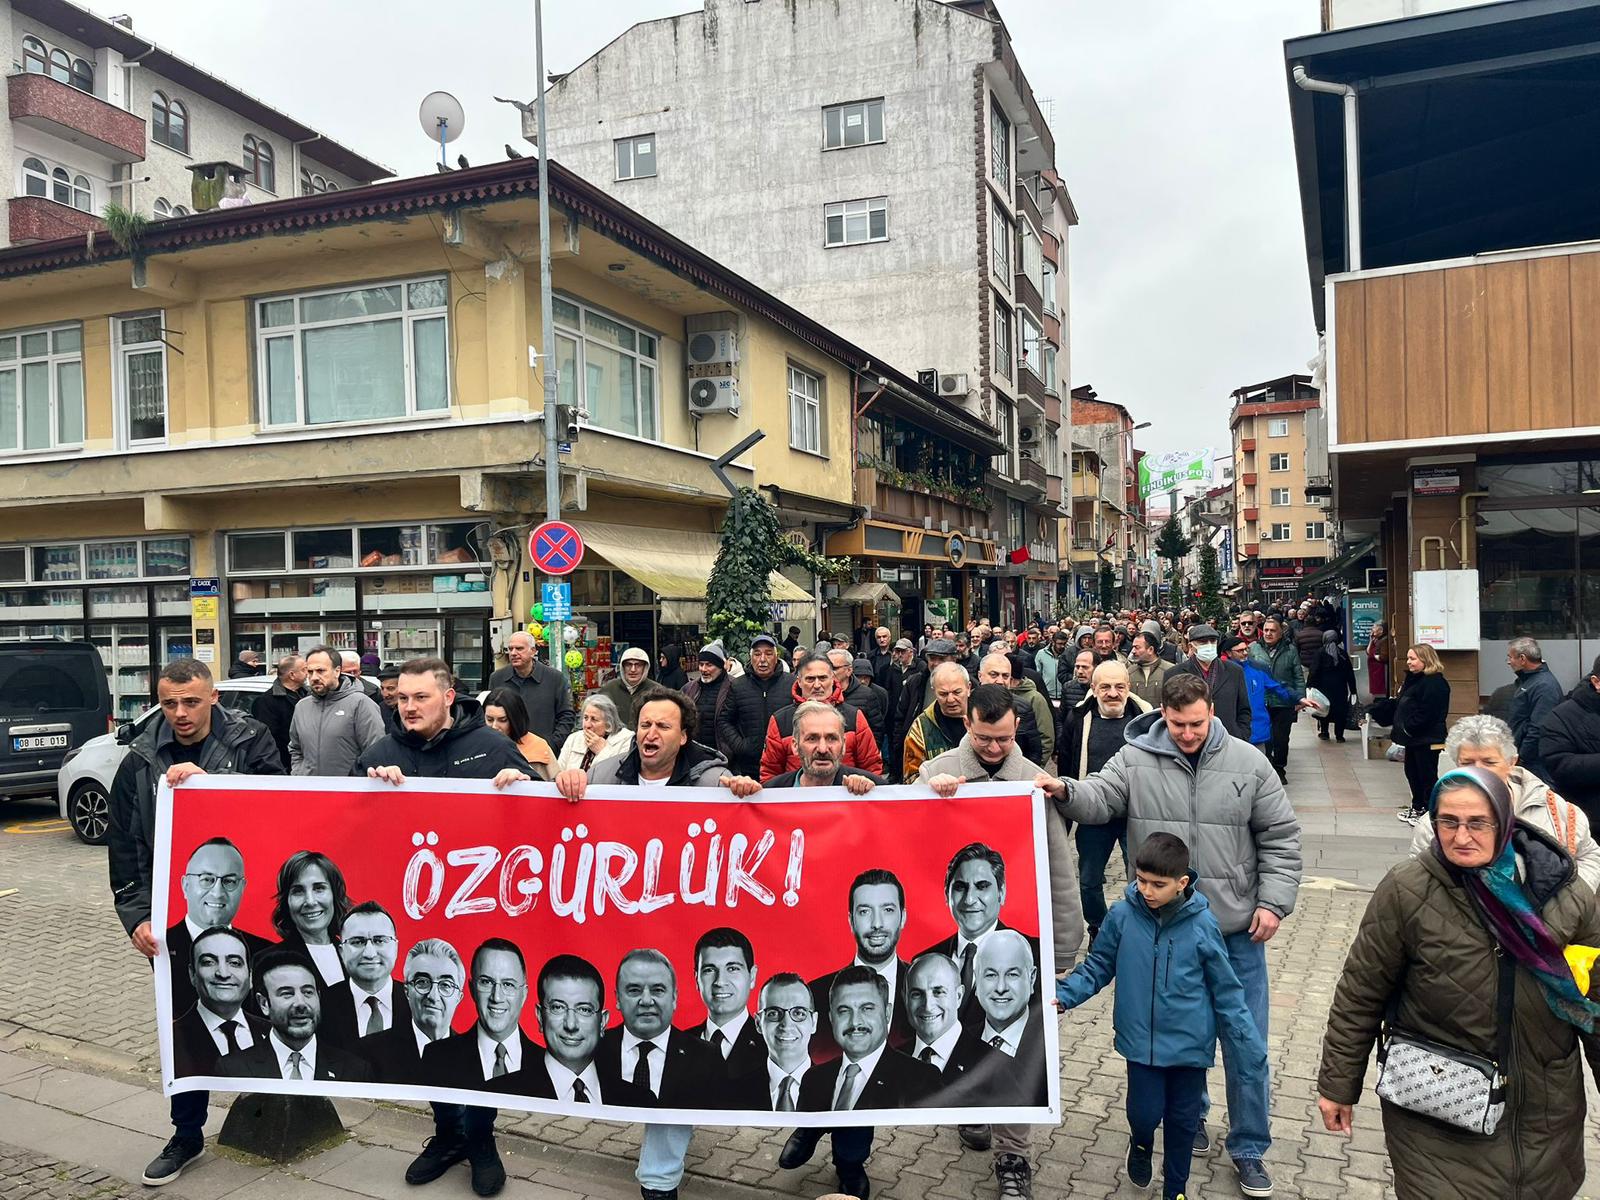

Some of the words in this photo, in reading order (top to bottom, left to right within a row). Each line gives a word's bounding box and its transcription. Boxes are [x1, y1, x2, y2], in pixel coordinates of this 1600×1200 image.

[19, 739, 30, 748] 08
[34, 738, 45, 747] DE
[50, 736, 65, 745] 019
[402, 818, 804, 924] ÖZGÜRLÜK!
